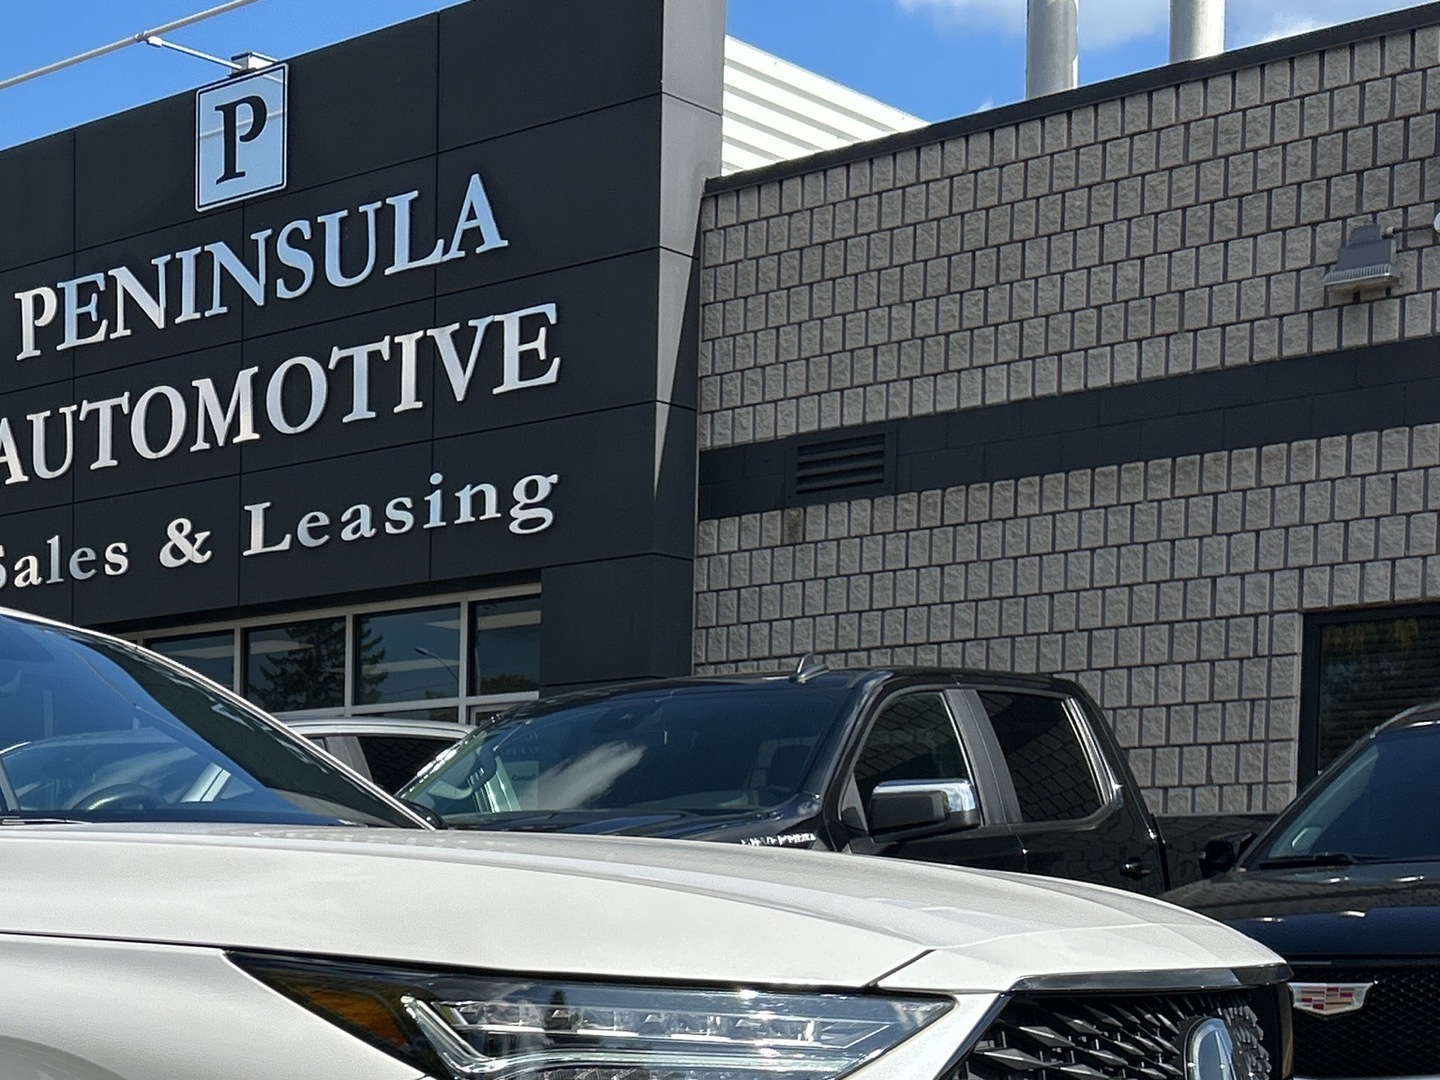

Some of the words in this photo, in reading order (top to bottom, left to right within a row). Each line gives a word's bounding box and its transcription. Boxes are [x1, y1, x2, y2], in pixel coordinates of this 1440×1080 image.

[215, 95, 268, 185] P
[14, 173, 509, 361] PENINSULA
[160, 518, 212, 568] &
[243, 473, 559, 557] Leasing
